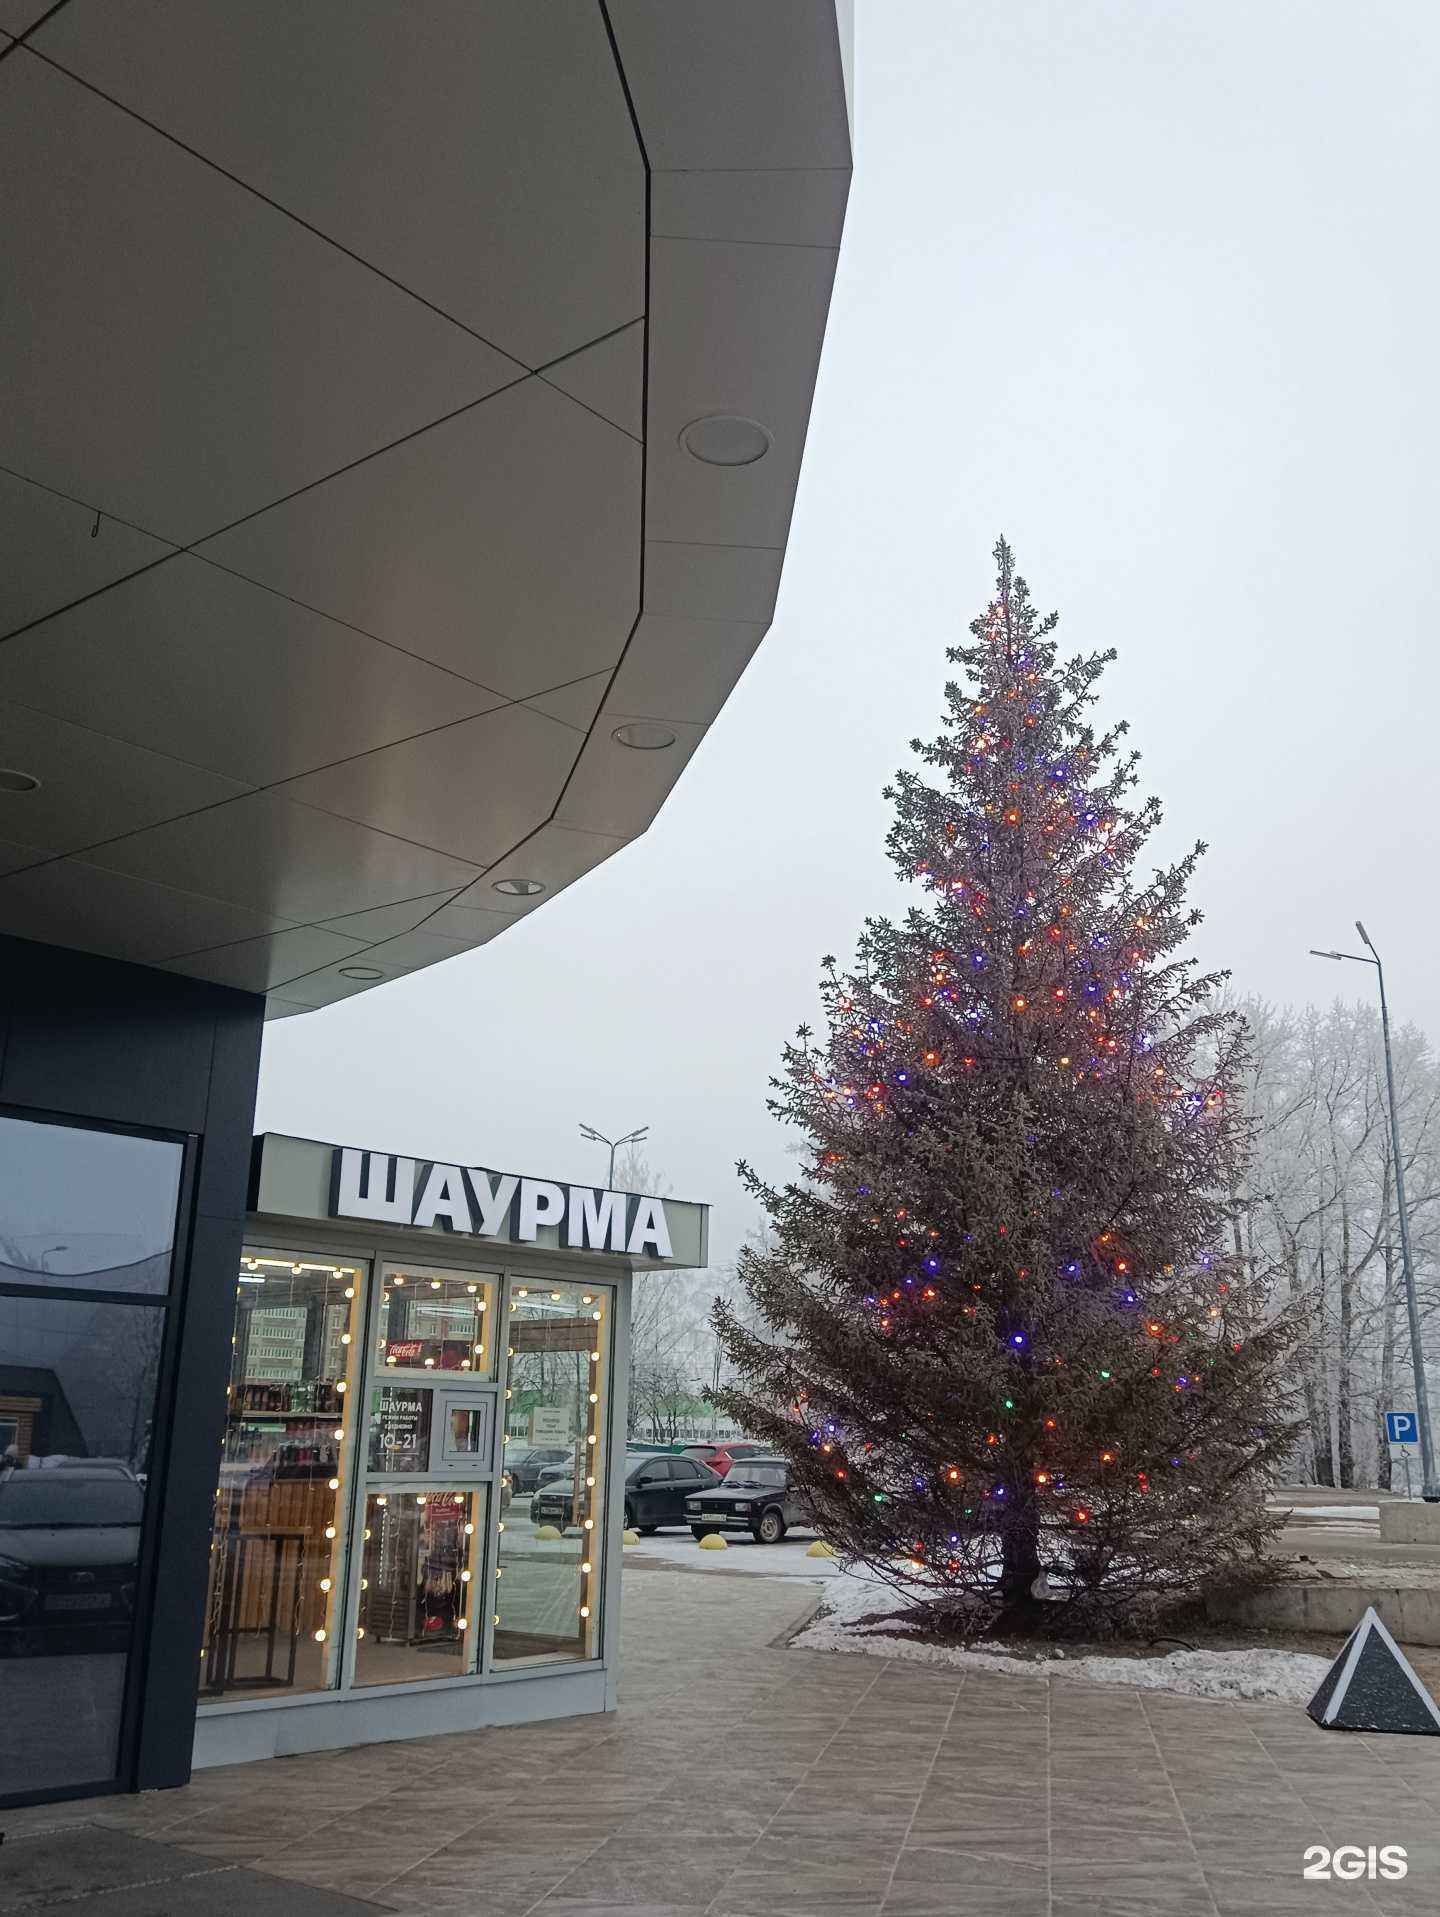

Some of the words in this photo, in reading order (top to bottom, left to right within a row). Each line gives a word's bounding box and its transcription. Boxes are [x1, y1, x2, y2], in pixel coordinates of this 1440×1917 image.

[336, 1147, 674, 1258] ШАУРМА
[379, 1399, 423, 1412] ШАУРМА
[379, 1432, 418, 1449] 10-21
